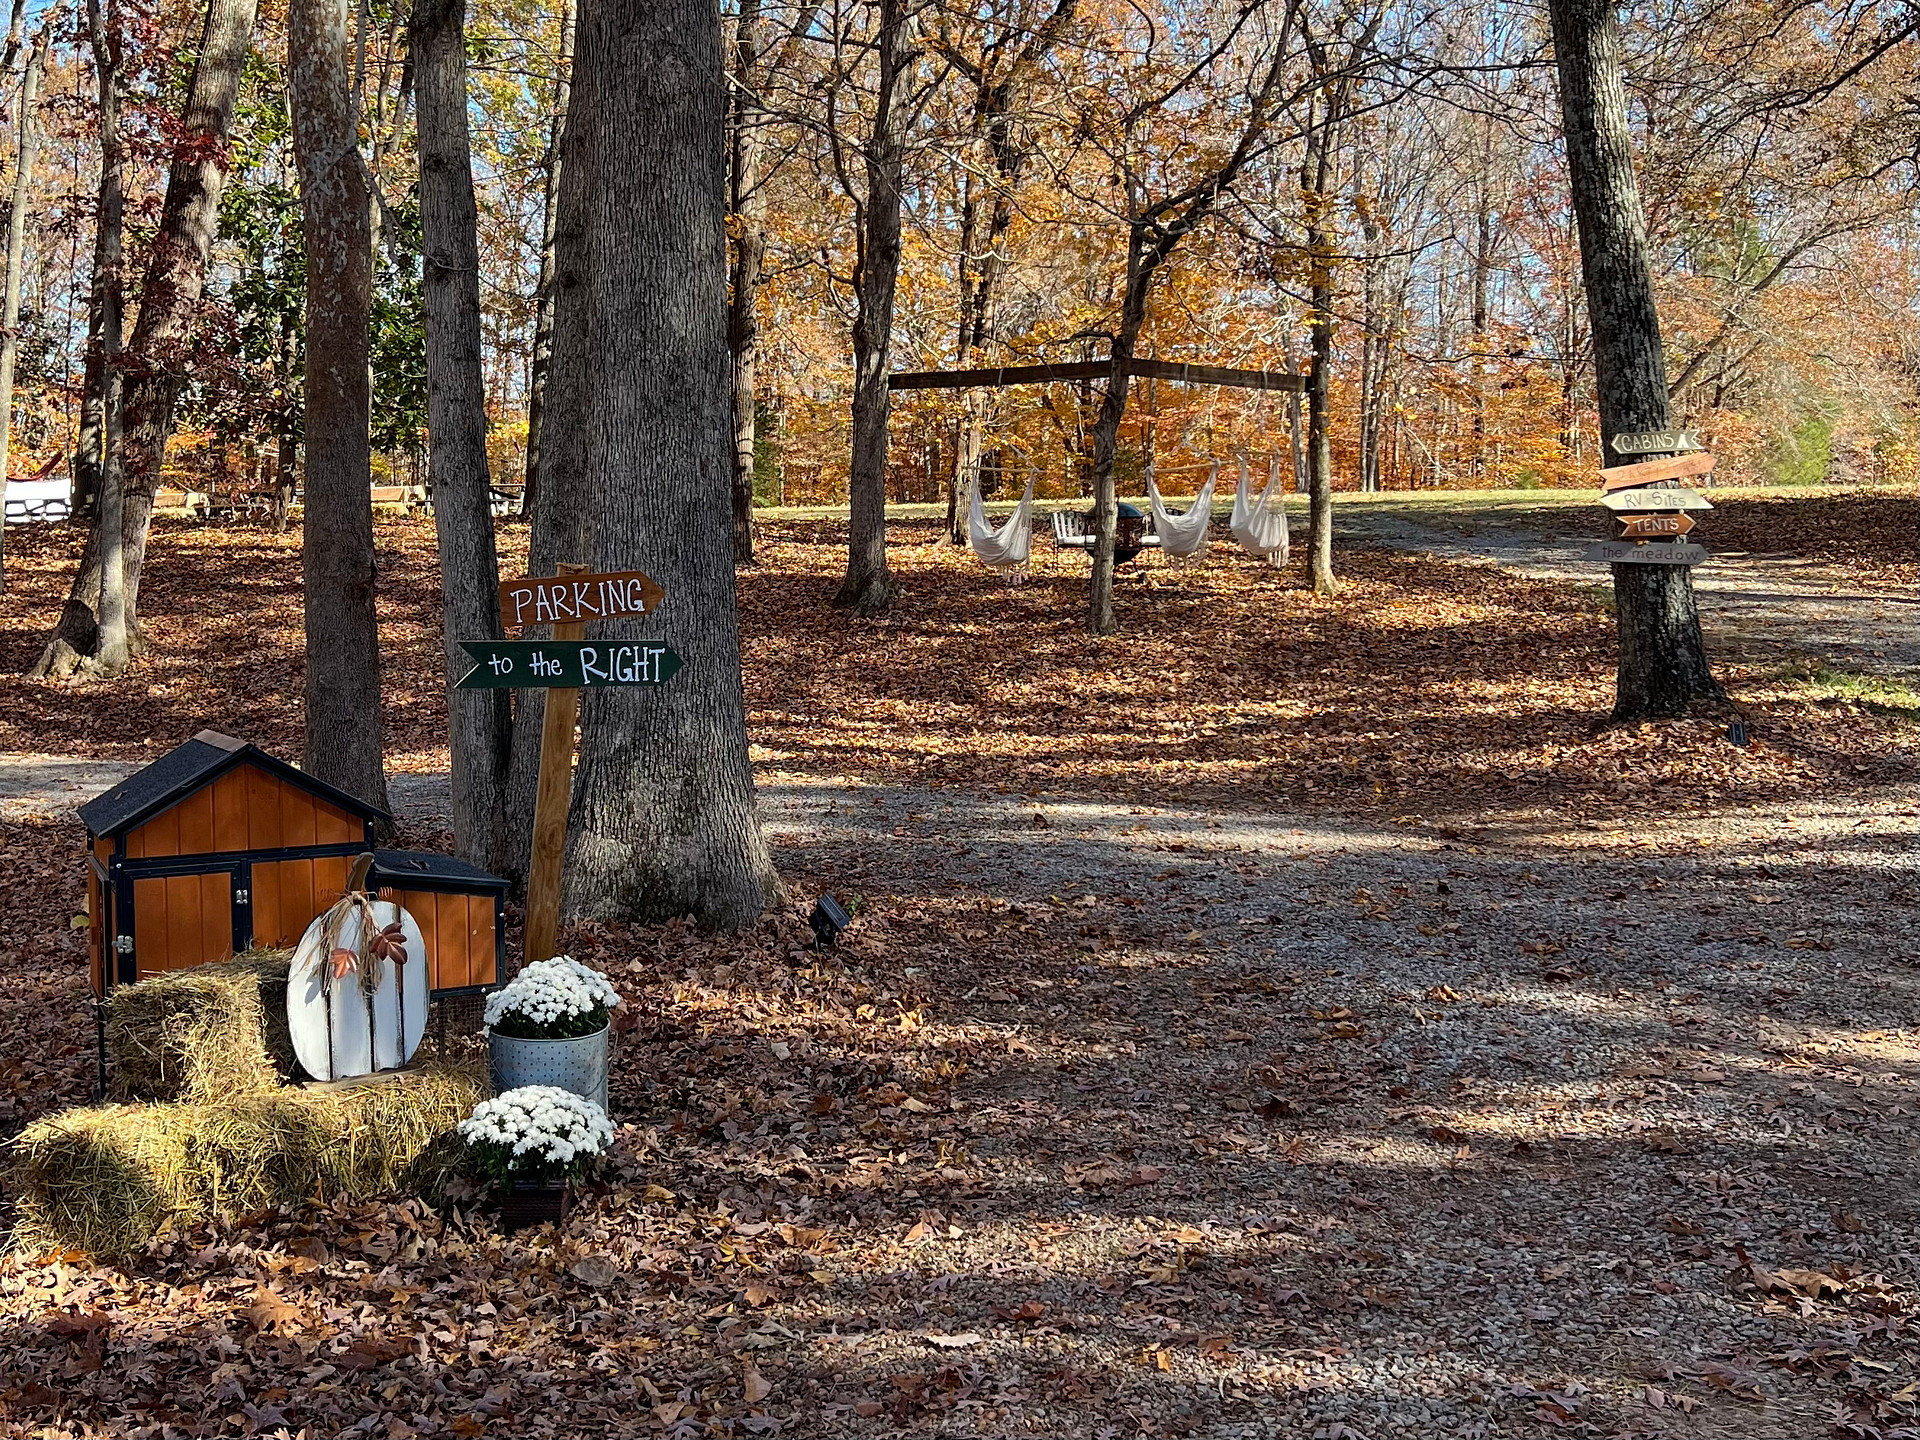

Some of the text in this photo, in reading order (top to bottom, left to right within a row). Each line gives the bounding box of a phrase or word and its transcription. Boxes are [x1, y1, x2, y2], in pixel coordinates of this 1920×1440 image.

[1621, 433, 1675, 452] CABINS
[1624, 493, 1643, 508] RV
[1632, 517, 1680, 533] TENTS
[1602, 546, 1700, 561] the meadow
[510, 578, 645, 623] PARKING
[488, 646, 666, 685] to the RIGHT
